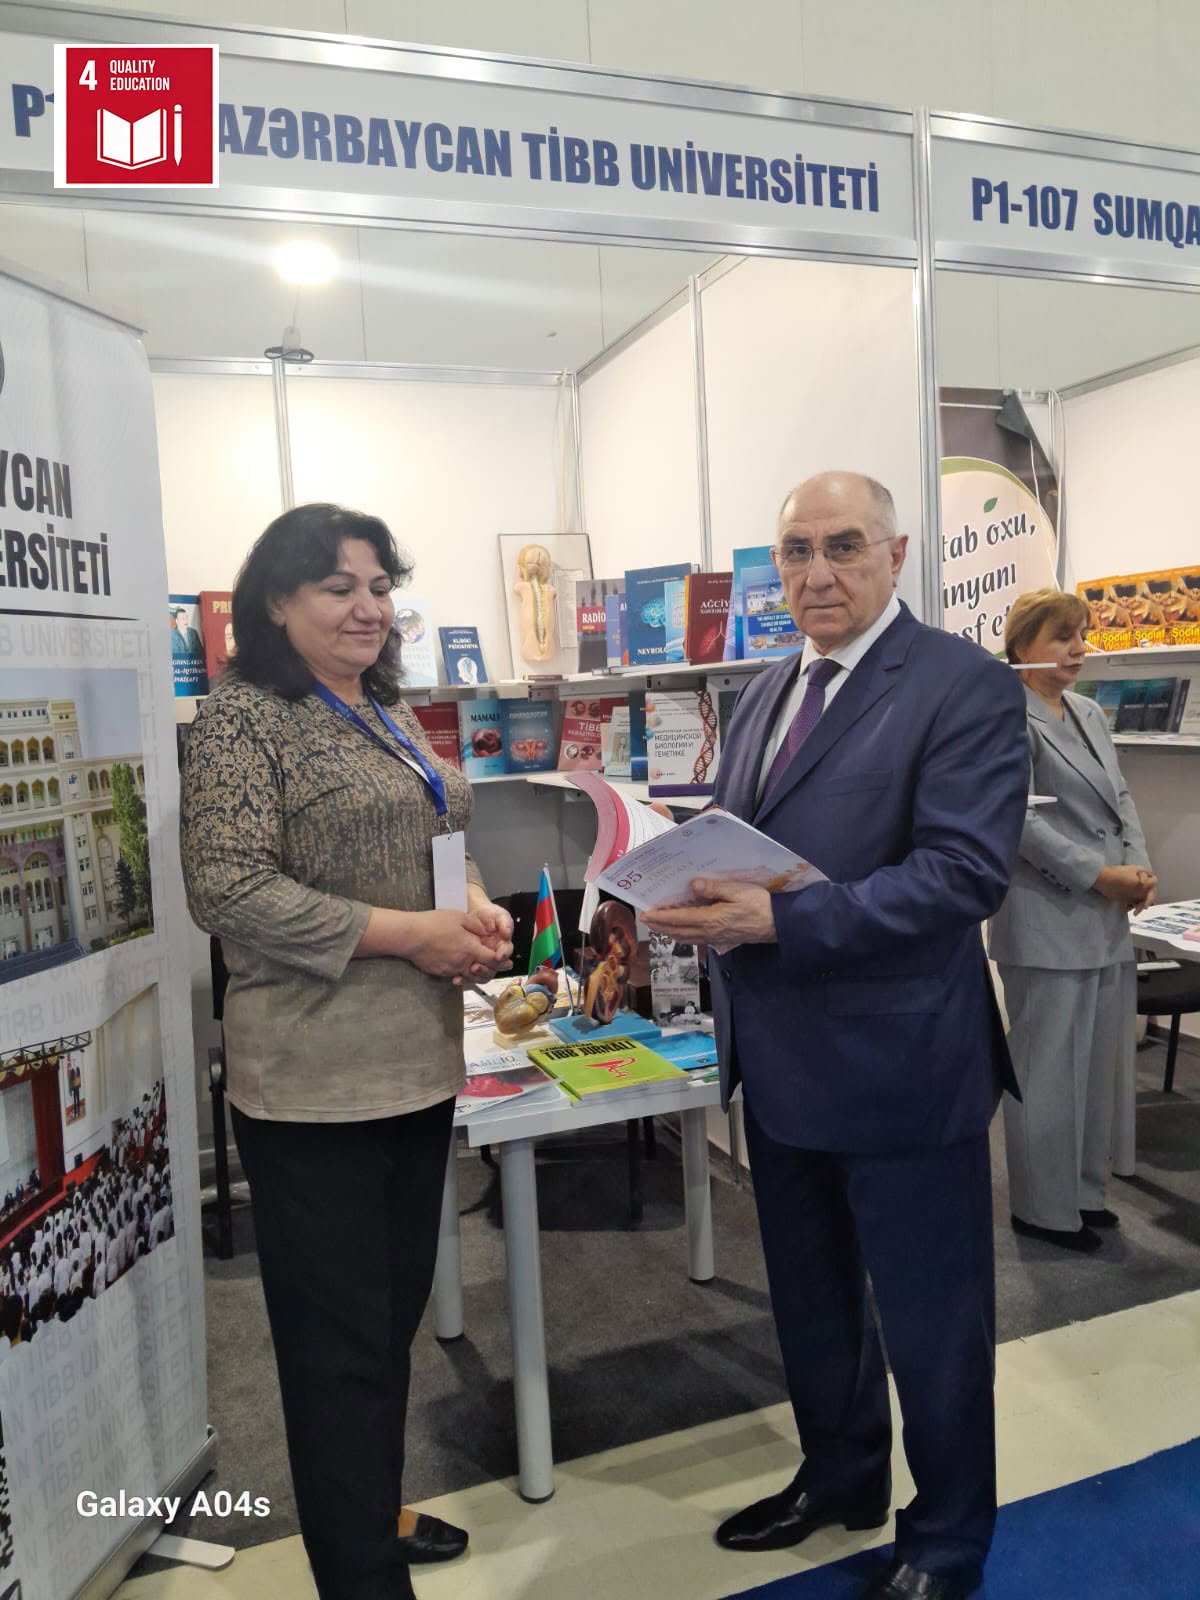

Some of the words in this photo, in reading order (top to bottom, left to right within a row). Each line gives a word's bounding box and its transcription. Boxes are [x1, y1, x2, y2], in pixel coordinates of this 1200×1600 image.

[521, 126, 620, 188] TİBB
[630, 141, 880, 213] UNİVERSİTETİ
[972, 177, 1078, 231] P1-107
[986, 513, 1035, 546] oxu,
